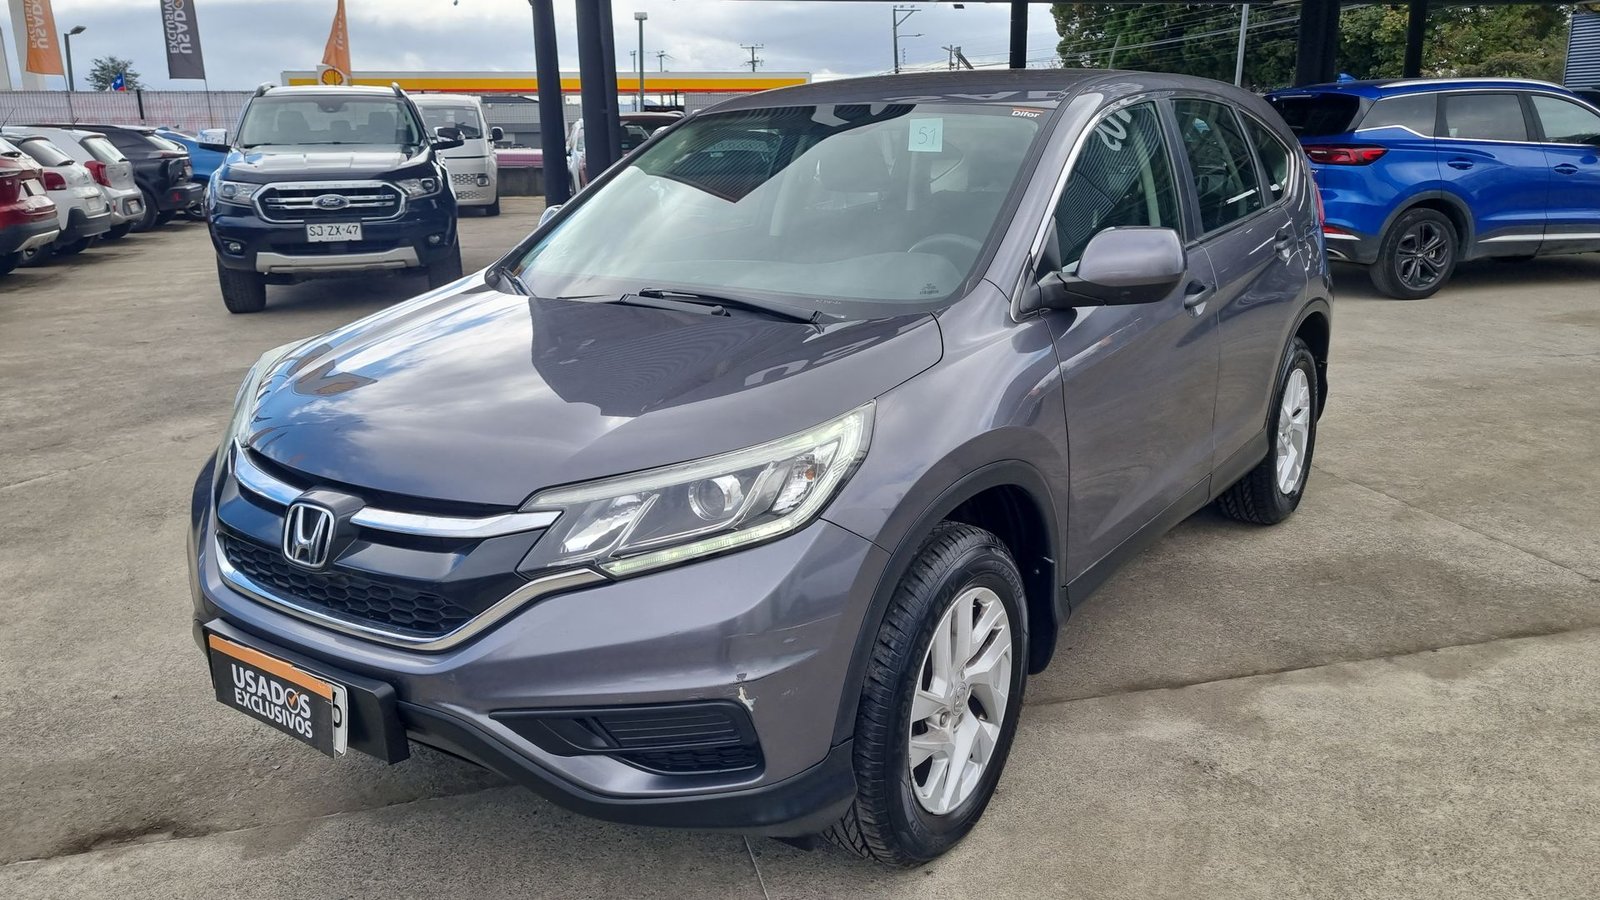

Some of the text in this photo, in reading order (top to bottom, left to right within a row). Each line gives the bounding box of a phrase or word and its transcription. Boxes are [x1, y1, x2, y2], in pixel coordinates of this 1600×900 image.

[1011, 110, 1040, 118] Difor
[231, 663, 312, 719] USADOS
[234, 686, 313, 739] EXCLUSIVOS
